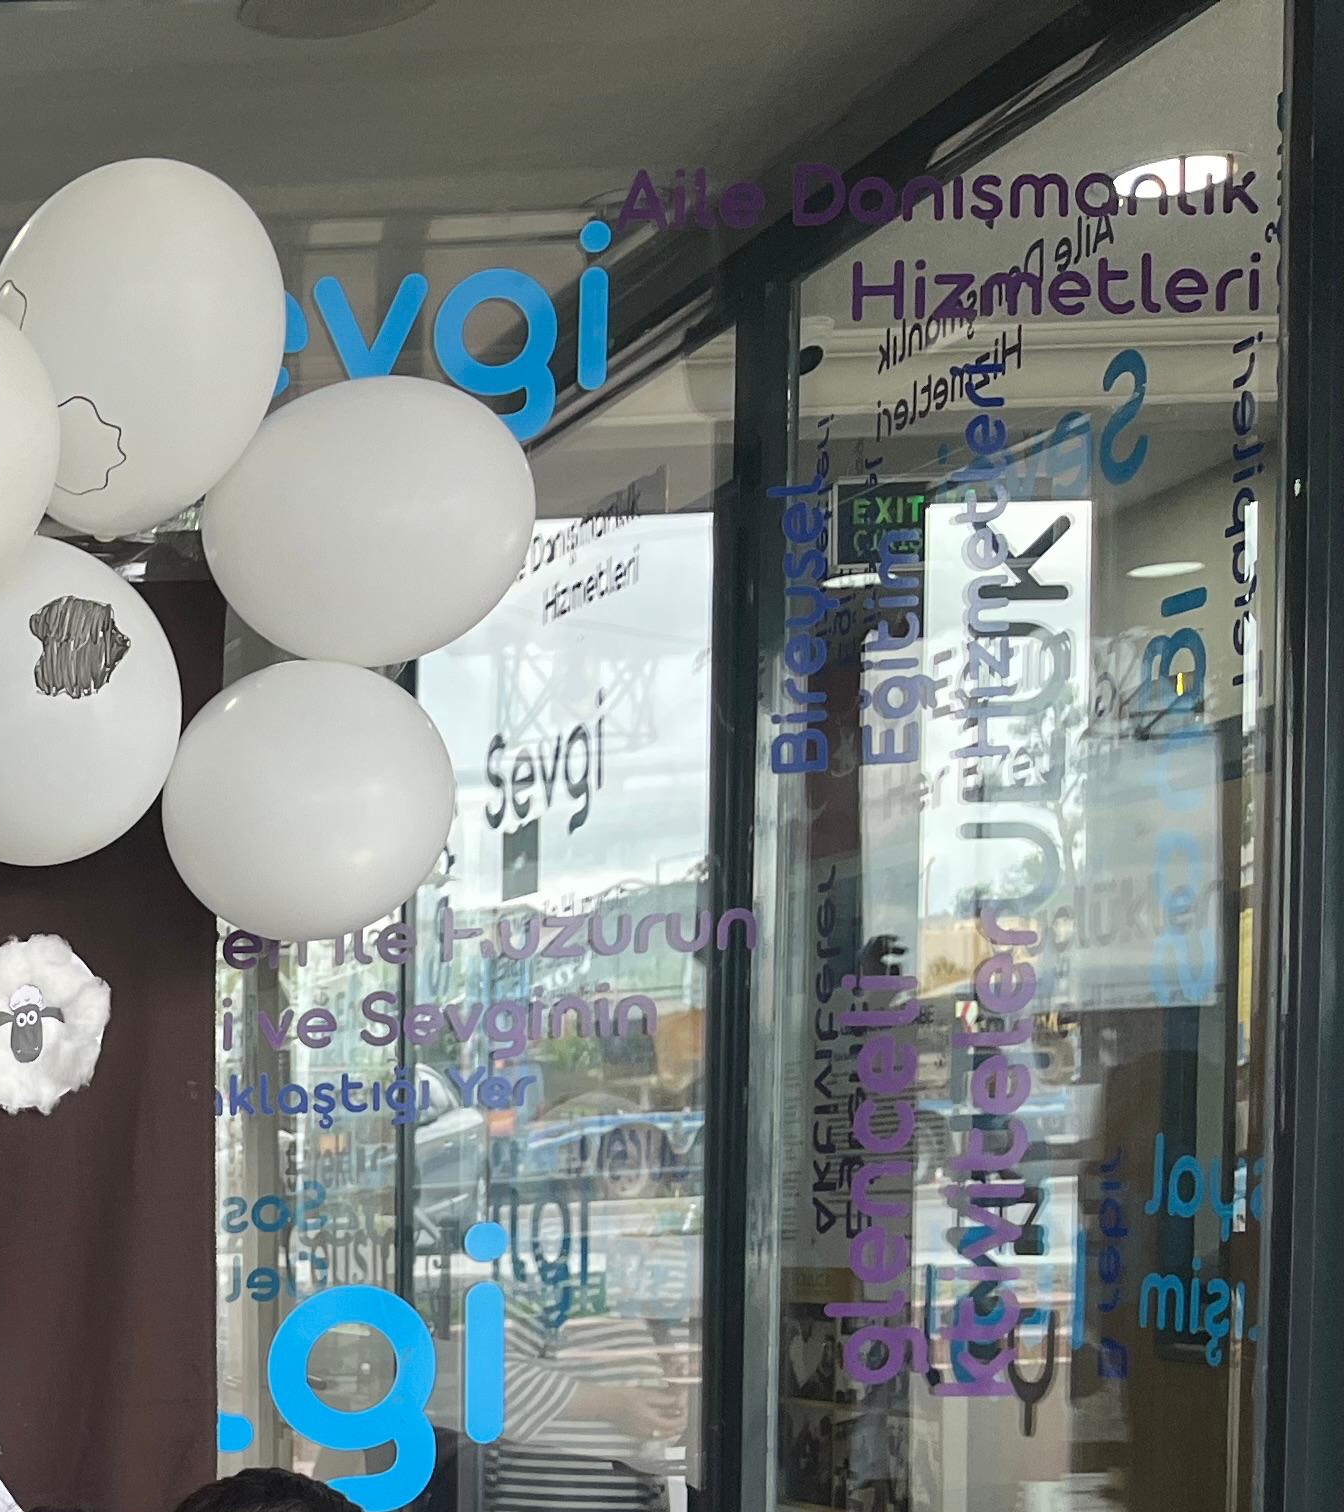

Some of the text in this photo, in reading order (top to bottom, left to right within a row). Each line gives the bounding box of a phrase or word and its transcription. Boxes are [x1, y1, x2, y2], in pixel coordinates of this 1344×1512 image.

[615, 167, 766, 231] Aile
[792, 154, 1260, 229] Danışmanlık
[852, 252, 1261, 322] Hizmetleri
[852, 495, 925, 525] EXIT
[766, 473, 841, 776] Bireysel
[859, 529, 938, 767] Eğitim
[484, 687, 606, 835] Sevgi
[257, 1007, 338, 1050] ve
[360, 982, 658, 1061] Sevginin
[444, 1064, 539, 1111] Yer
